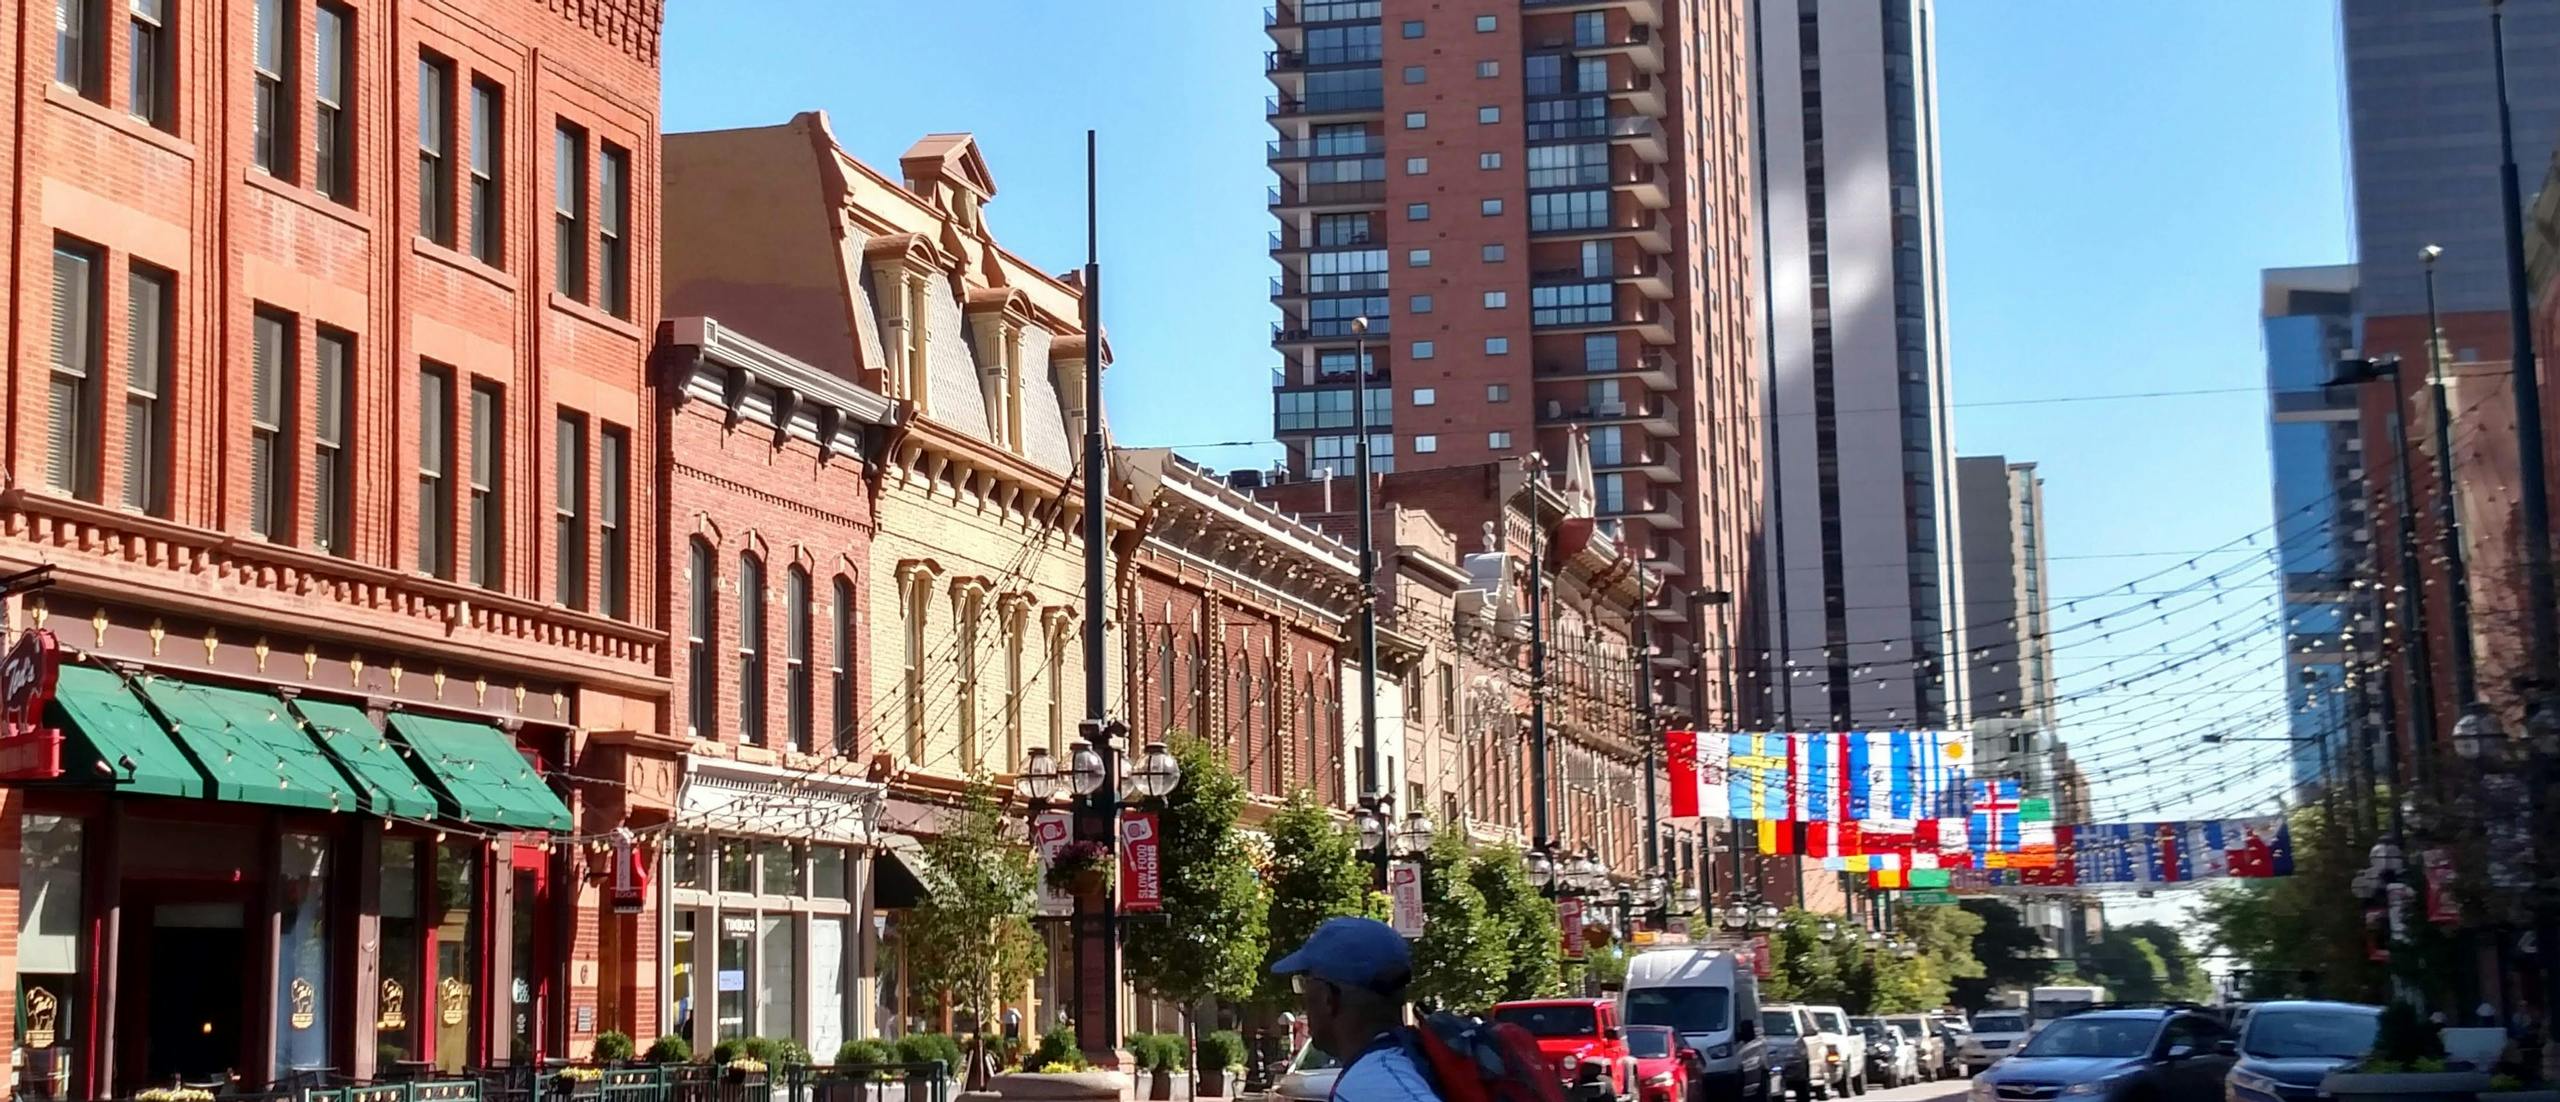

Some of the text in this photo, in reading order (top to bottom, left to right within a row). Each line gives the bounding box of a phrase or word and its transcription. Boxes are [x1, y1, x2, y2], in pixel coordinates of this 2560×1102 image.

[5, 656, 35, 701] Ted's
[1137, 844, 1148, 899] SLOW FOOD
[1147, 844, 1158, 899] NATIONS
